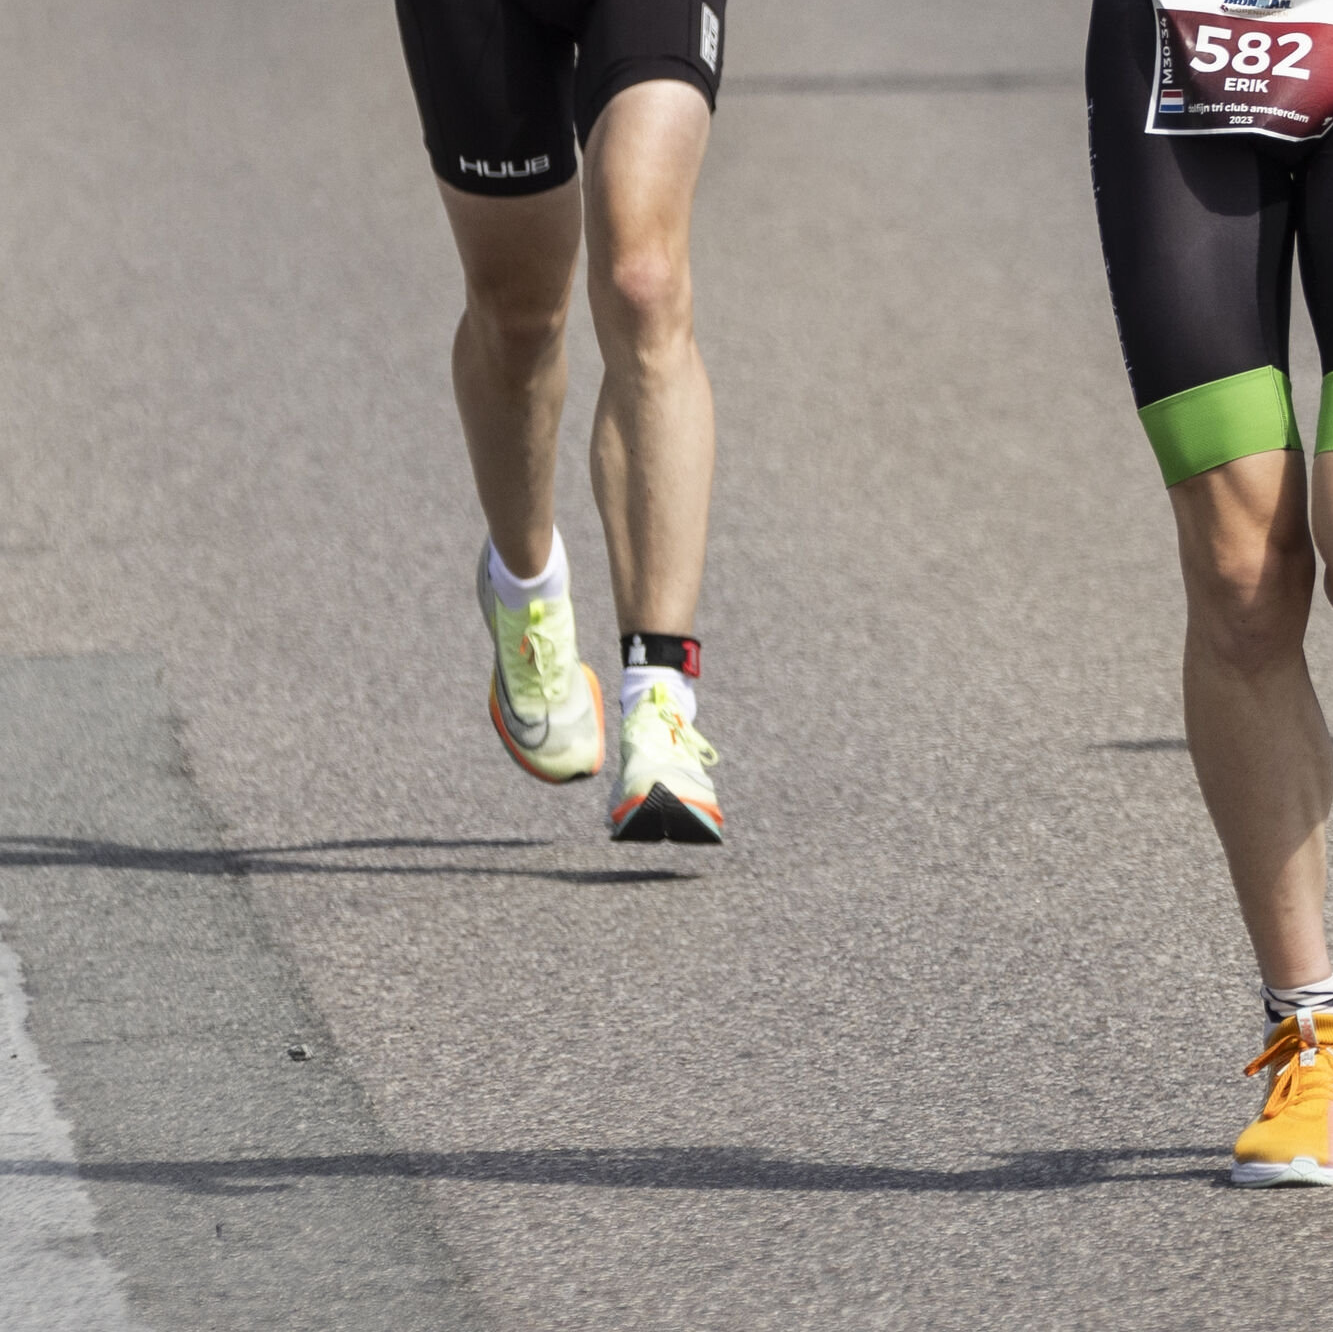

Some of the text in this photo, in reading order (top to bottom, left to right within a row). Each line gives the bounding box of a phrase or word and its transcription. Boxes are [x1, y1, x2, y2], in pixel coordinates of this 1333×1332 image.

[1160, 16, 1174, 85] M30-34
[1189, 25, 1314, 81] 582
[1223, 77, 1271, 94] ERIK
[1211, 102, 1224, 112] tri
[1224, 102, 1249, 112] club
[1250, 105, 1310, 124] amsterdam
[1229, 115, 1254, 125] 2023
[459, 154, 550, 178] HUUB
